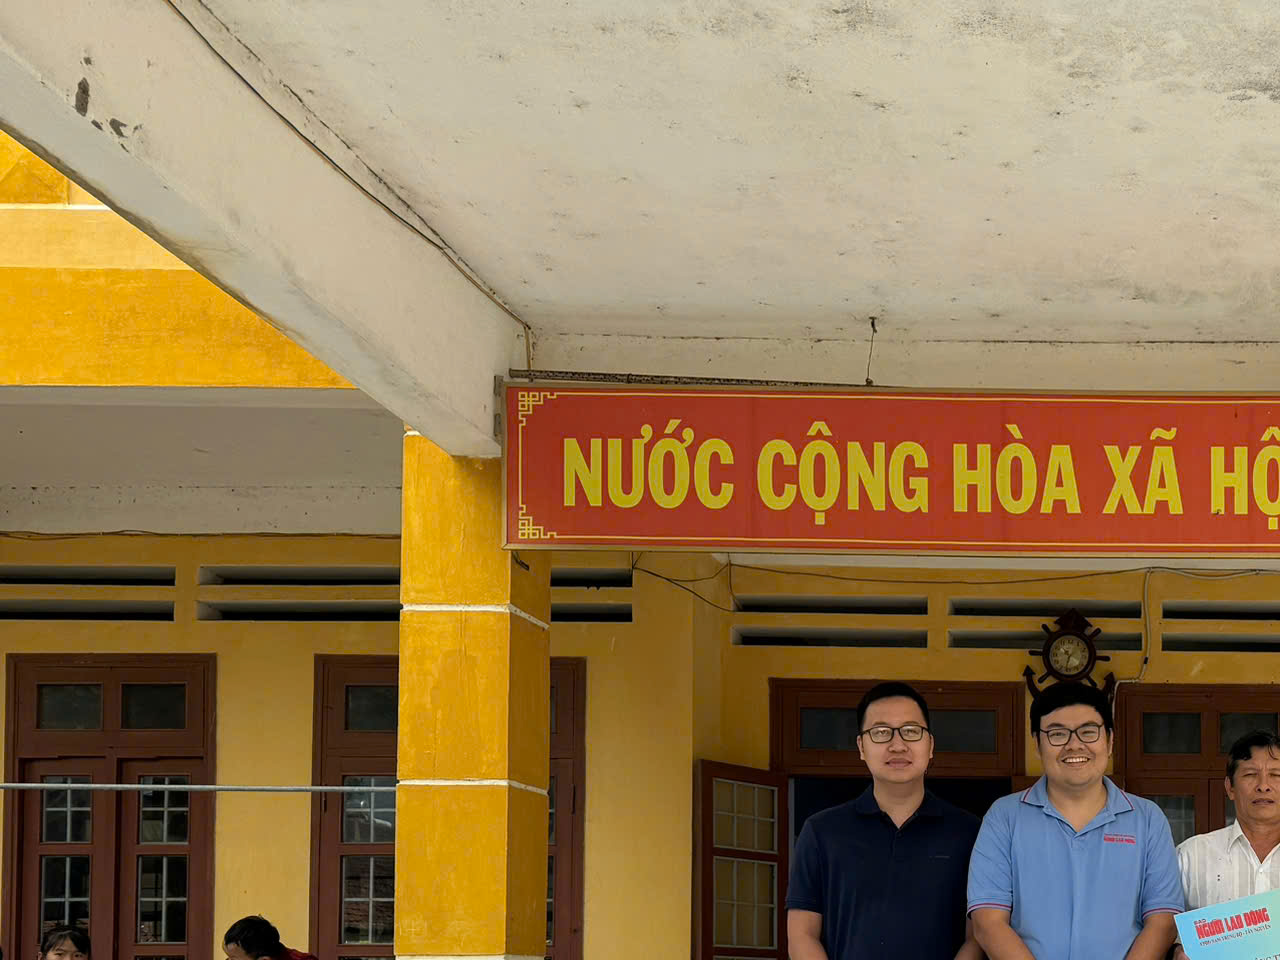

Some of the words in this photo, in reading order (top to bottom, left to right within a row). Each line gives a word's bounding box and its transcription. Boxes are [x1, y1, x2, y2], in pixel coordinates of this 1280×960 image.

[562, 419, 735, 510] NƯỚC
[757, 421, 930, 525] CỘNG
[953, 423, 1082, 516] HÒA
[1102, 428, 1184, 516] XÃ
[1223, 914, 1243, 931] LAO
